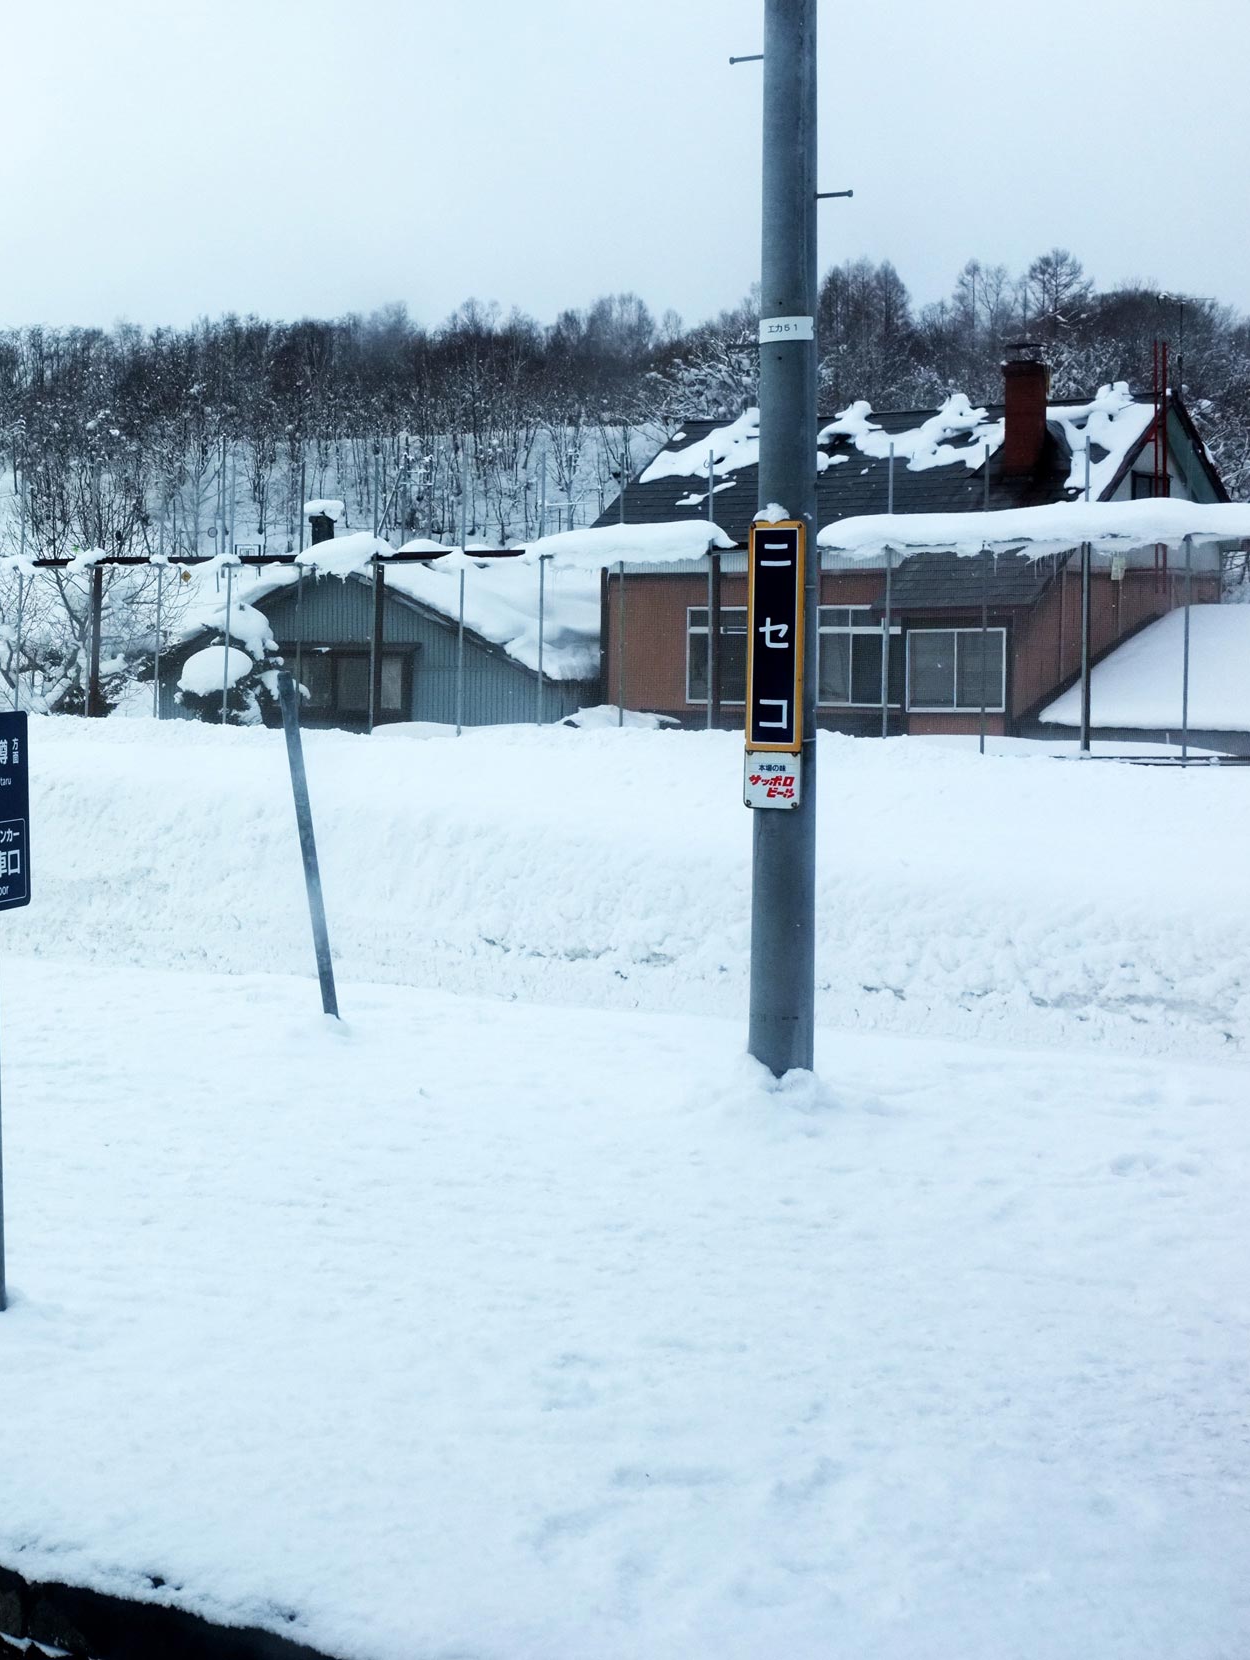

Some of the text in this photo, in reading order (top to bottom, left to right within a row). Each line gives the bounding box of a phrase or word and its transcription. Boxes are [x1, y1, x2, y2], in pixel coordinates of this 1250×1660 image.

[759, 543, 791, 729] ニセコ
[749, 774, 795, 787] サッポロ
[766, 787, 795, 799] ビール
